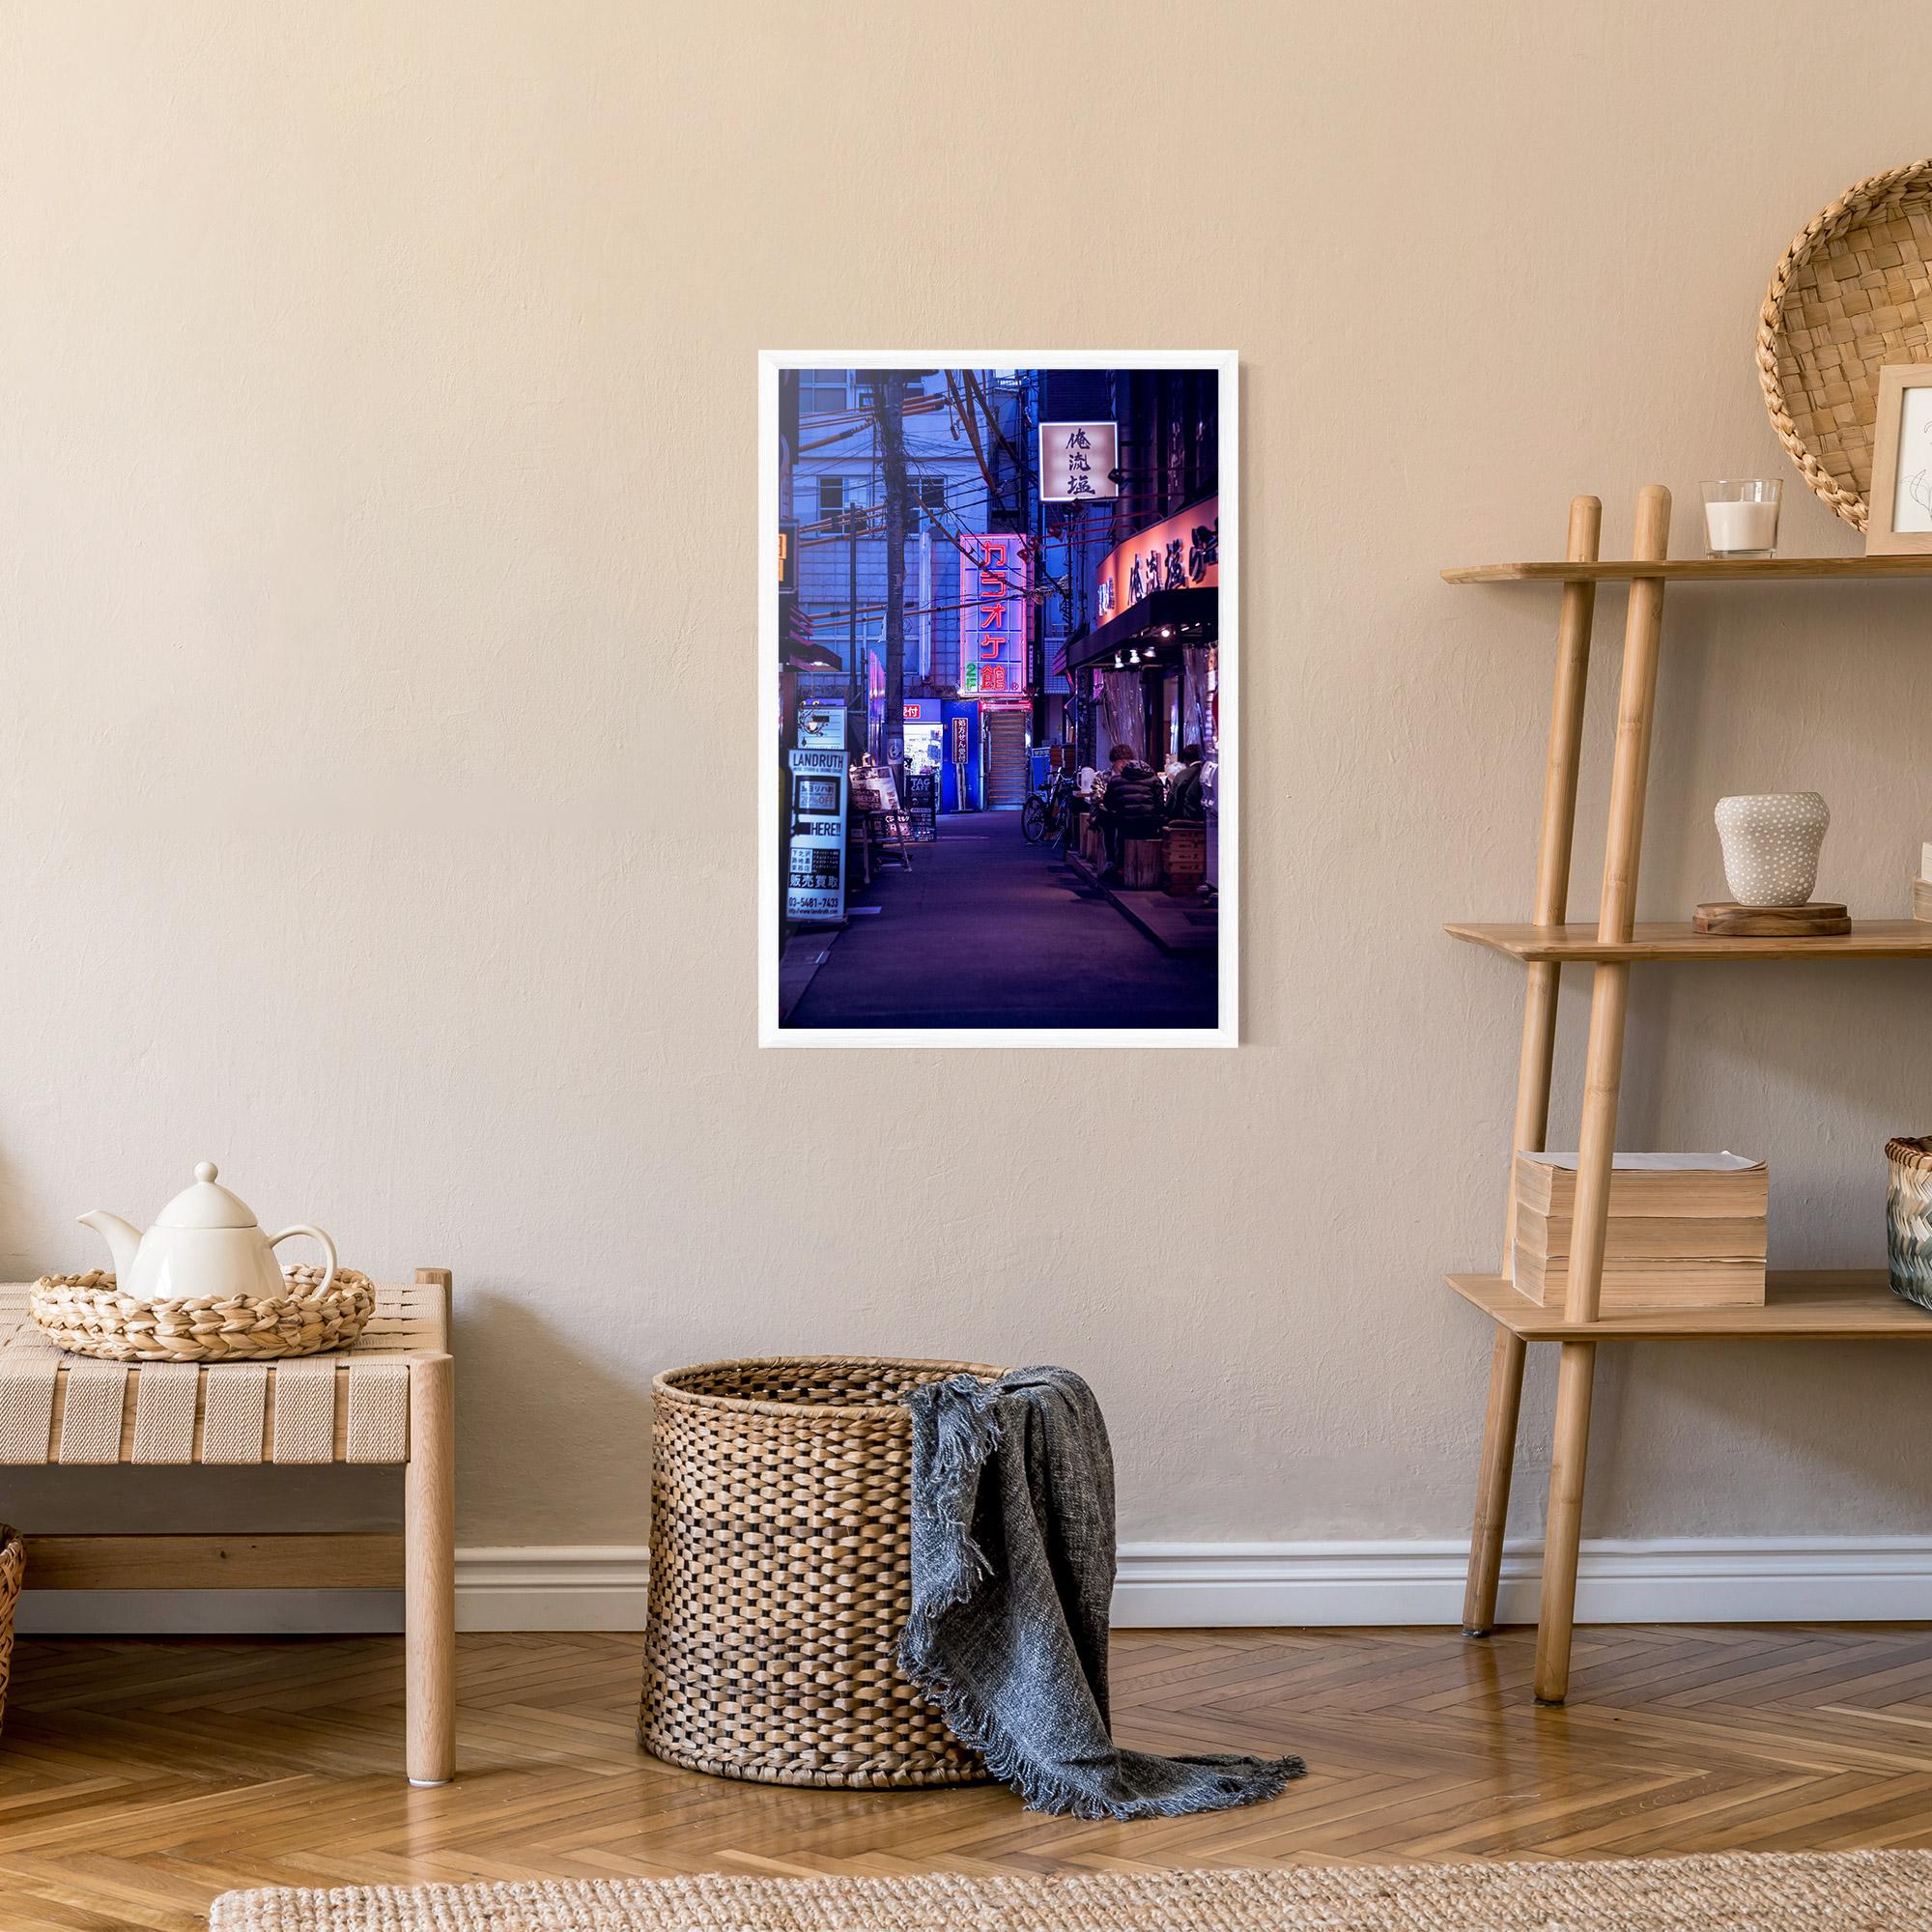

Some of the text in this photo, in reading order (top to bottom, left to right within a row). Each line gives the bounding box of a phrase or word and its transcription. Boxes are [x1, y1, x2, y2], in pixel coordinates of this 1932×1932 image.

[1065, 428, 1096, 496] 俺流塩
[980, 541, 1007, 691] カラオケ館
[966, 663, 978, 691] 2F
[957, 719, 966, 762] 処方せん受付
[793, 753, 843, 769] LANDRUTH
[910, 778, 931, 786] TAG
[811, 822, 841, 837] HERE!!
[790, 874, 838, 888] 販売買取
